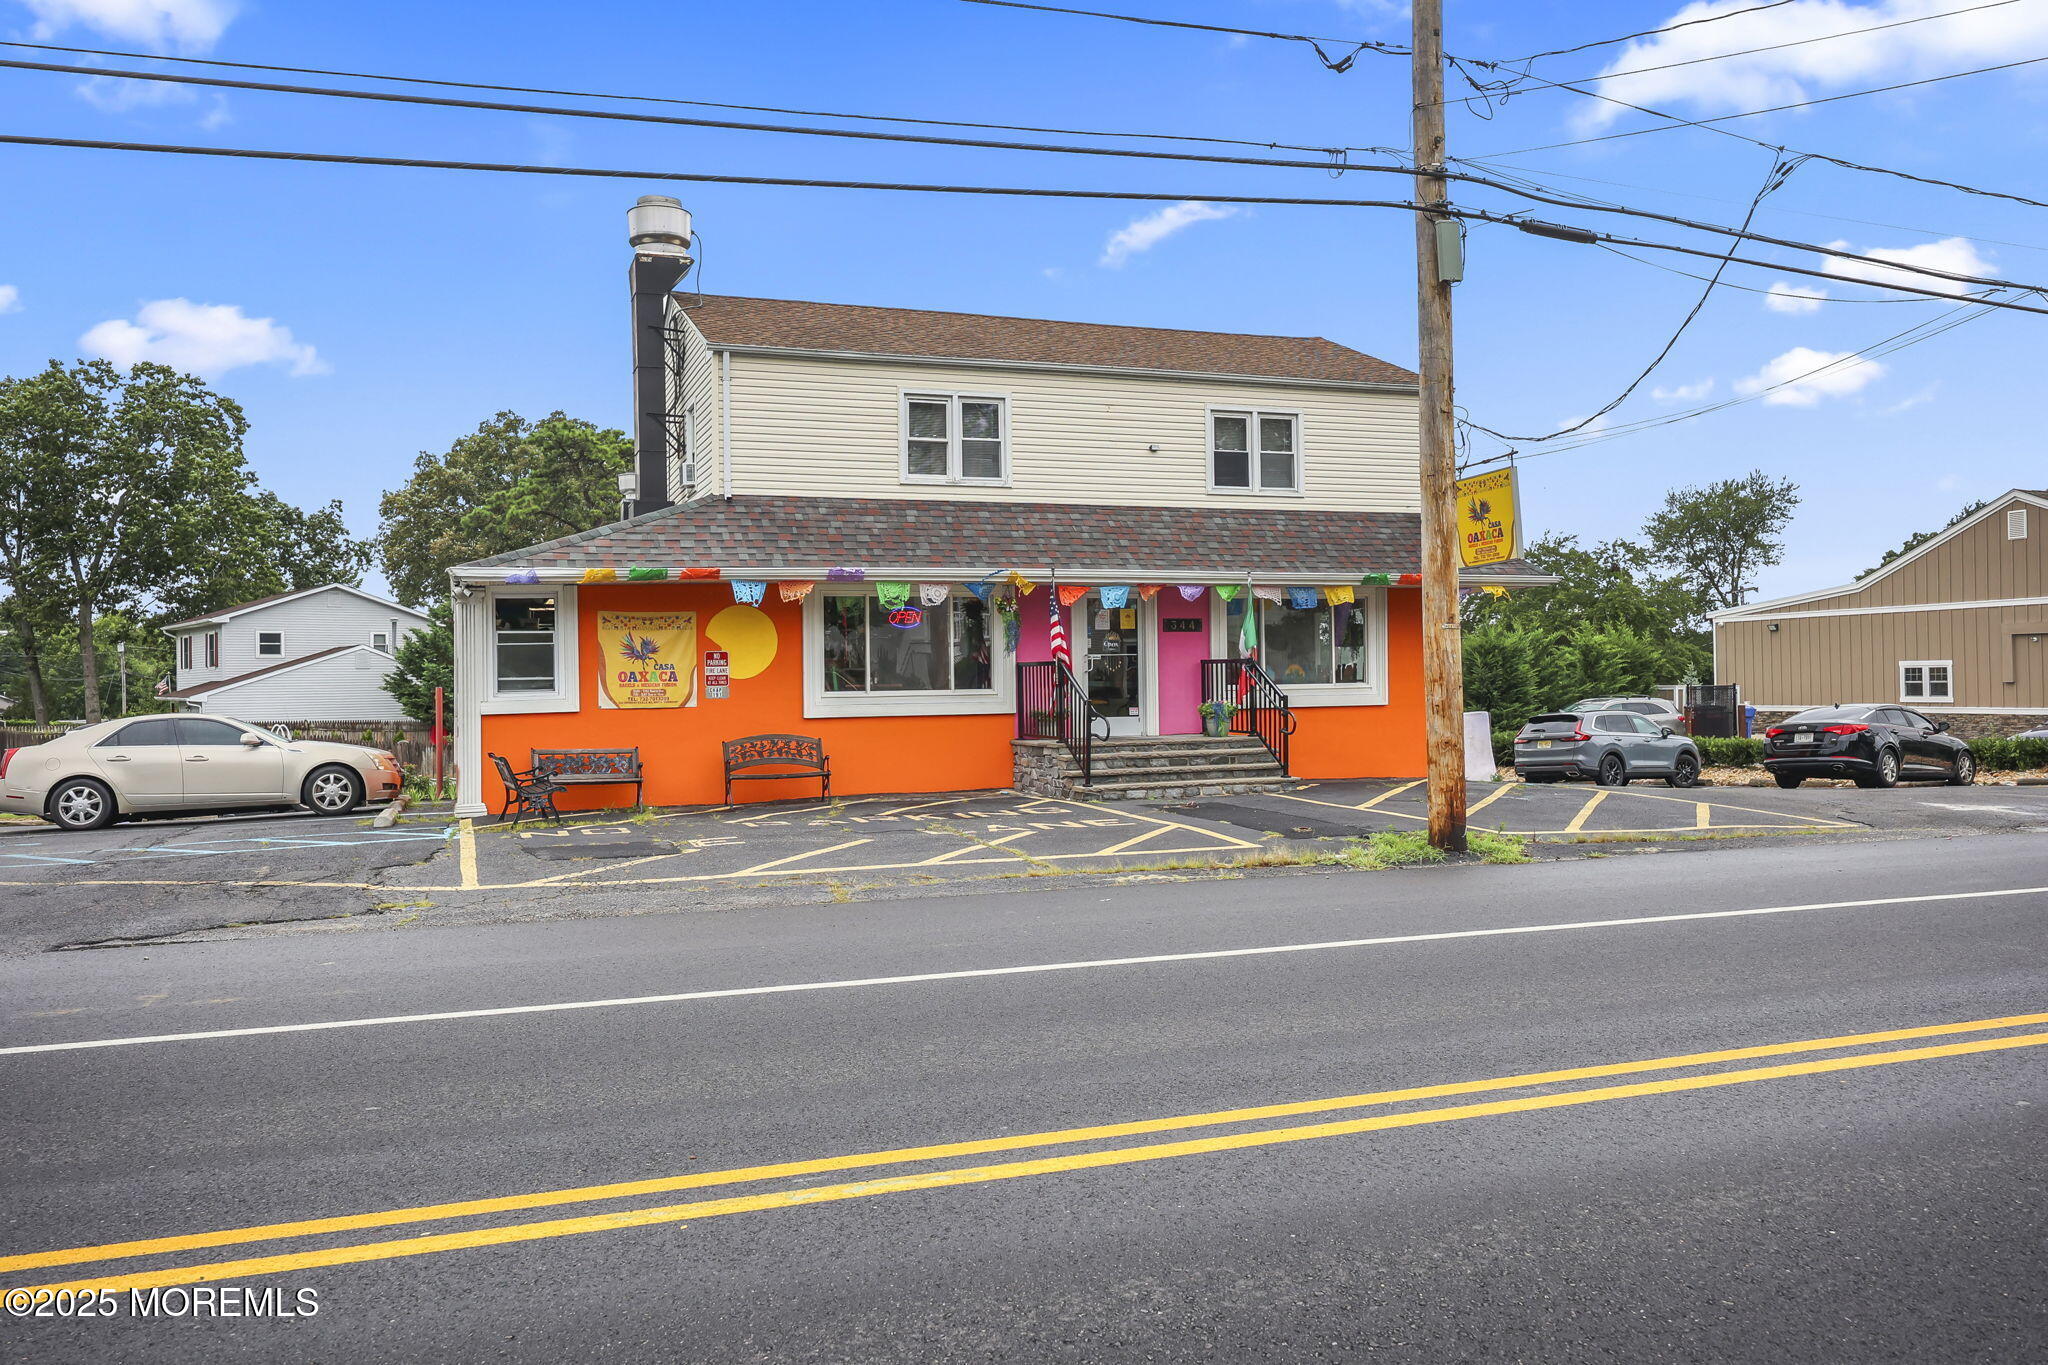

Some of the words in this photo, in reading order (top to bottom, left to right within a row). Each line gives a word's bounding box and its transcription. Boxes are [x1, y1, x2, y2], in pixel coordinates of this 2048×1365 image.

[1467, 527, 1504, 543] OAXACA
[888, 611, 923, 625] OPEN
[1103, 640, 1120, 649] Open
[653, 663, 675, 671] CASA
[617, 671, 679, 683] OAXACA
[519, 827, 632, 839] NO
[735, 806, 1072, 828] PARKING
